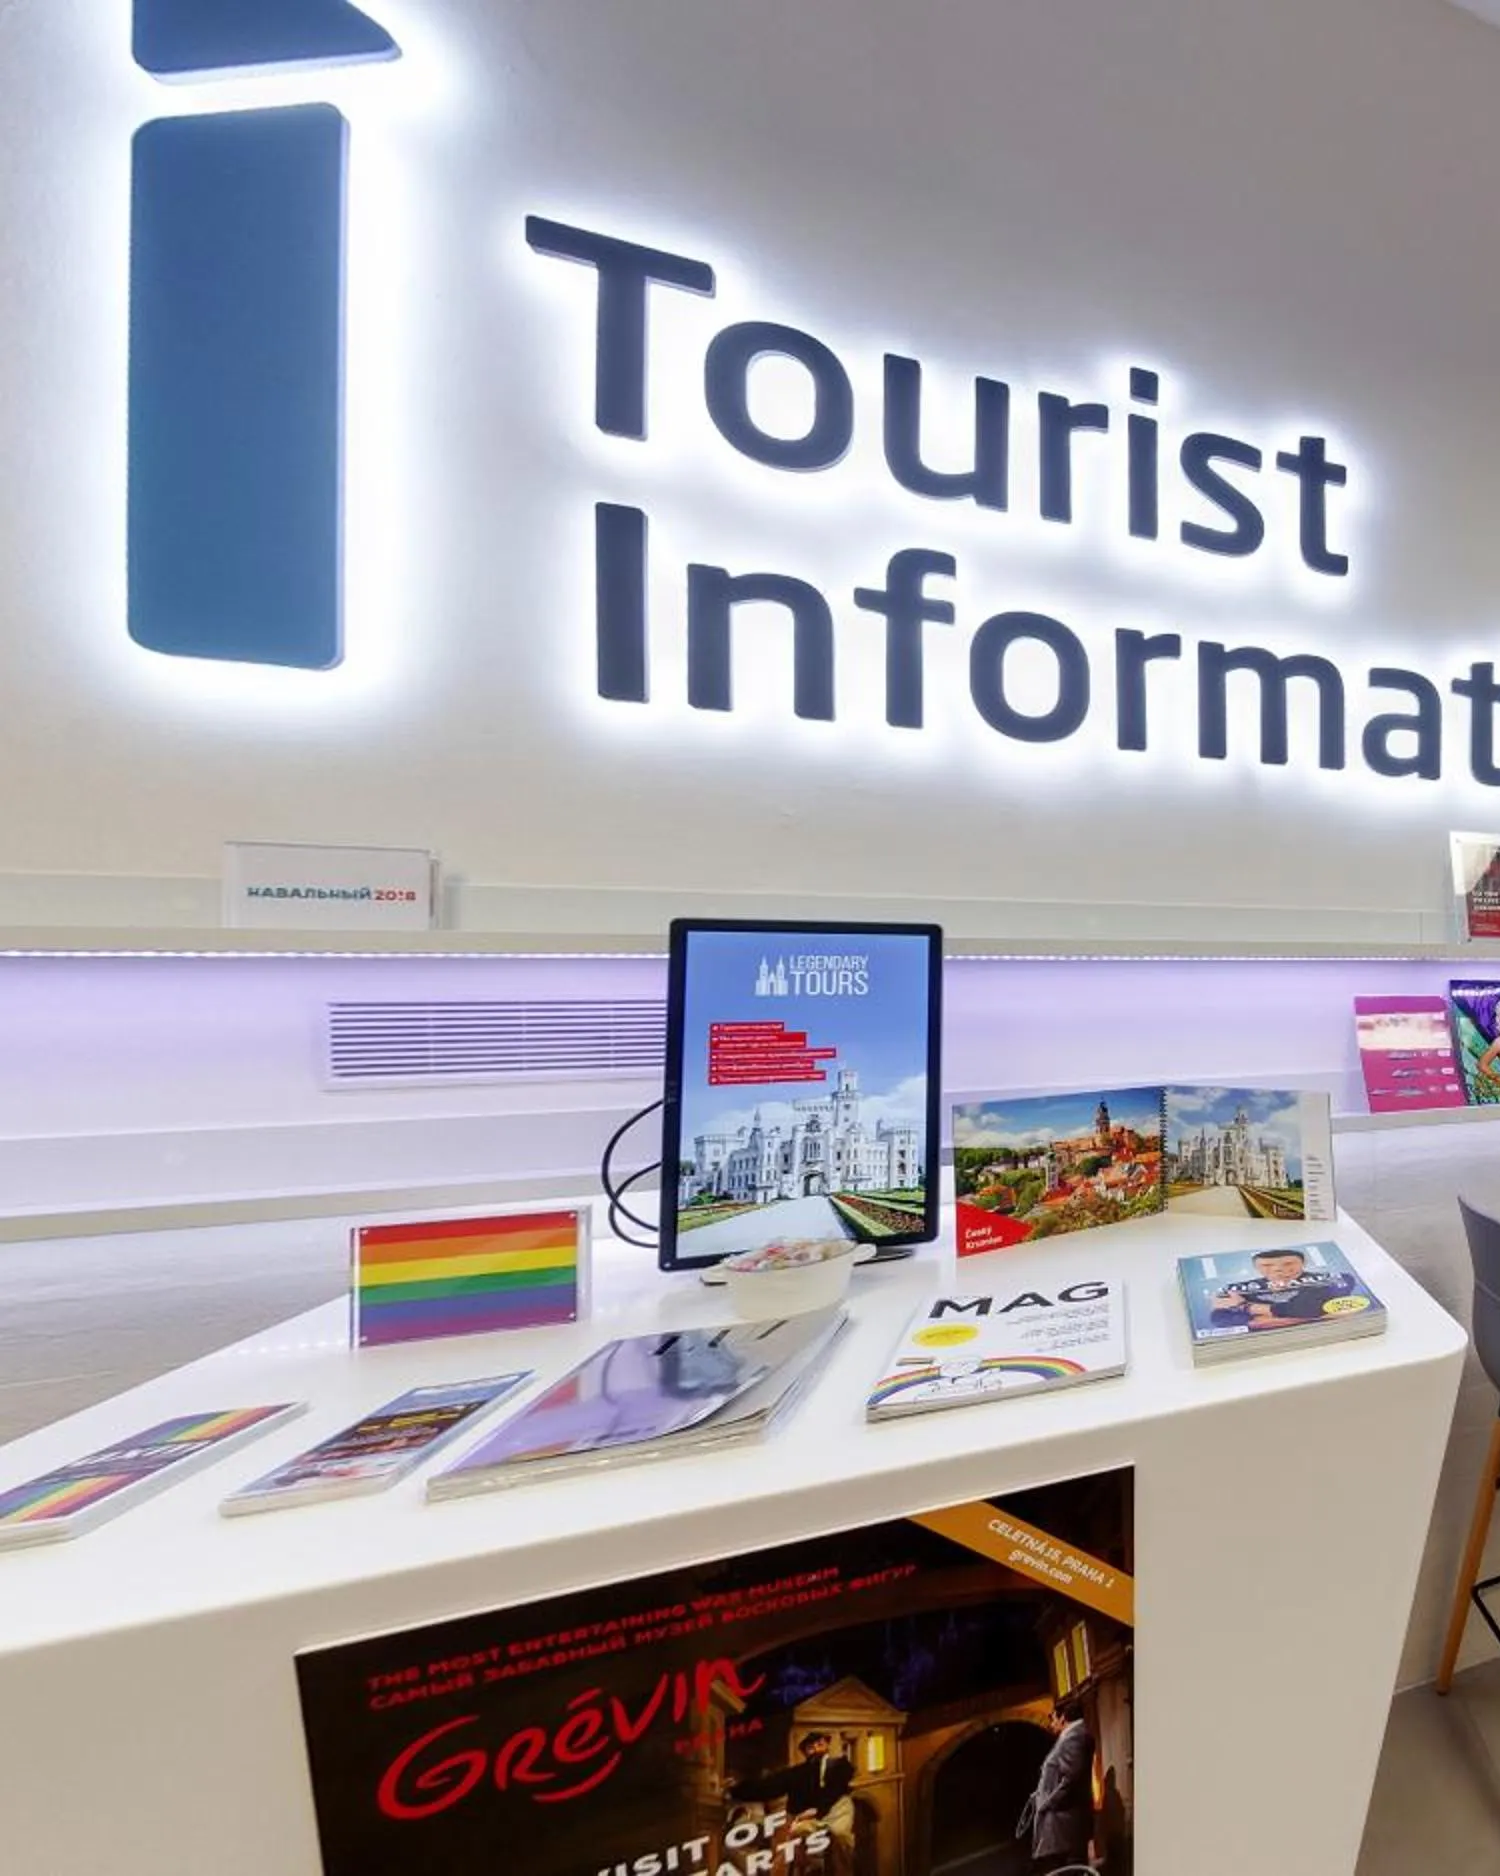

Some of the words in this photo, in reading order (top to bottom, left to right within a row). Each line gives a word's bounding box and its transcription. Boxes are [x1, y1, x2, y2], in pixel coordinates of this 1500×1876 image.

[525, 214, 1349, 576] Tourist
[248, 887, 371, 900] НАВАЛЬНЫЙ
[789, 954, 869, 970] LEGENDARY
[789, 970, 869, 996] TOURS
[928, 1281, 1109, 1319] MAG
[987, 1518, 1047, 1556] CELETNÁ
[1061, 1555, 1105, 1586] PRAHA
[367, 1665, 421, 1691] THE
[427, 1648, 501, 1677] MOST
[507, 1603, 686, 1657] ENTERTAINING
[749, 1566, 840, 1597] MUSEUM
[369, 1671, 474, 1712] САМЫЙ
[483, 1635, 627, 1684] ЗАБАВНЫЙ
[633, 1612, 714, 1645] МУЗЕЙ
[597, 1836, 710, 1876] ISIT
[724, 1809, 788, 1849] OF
